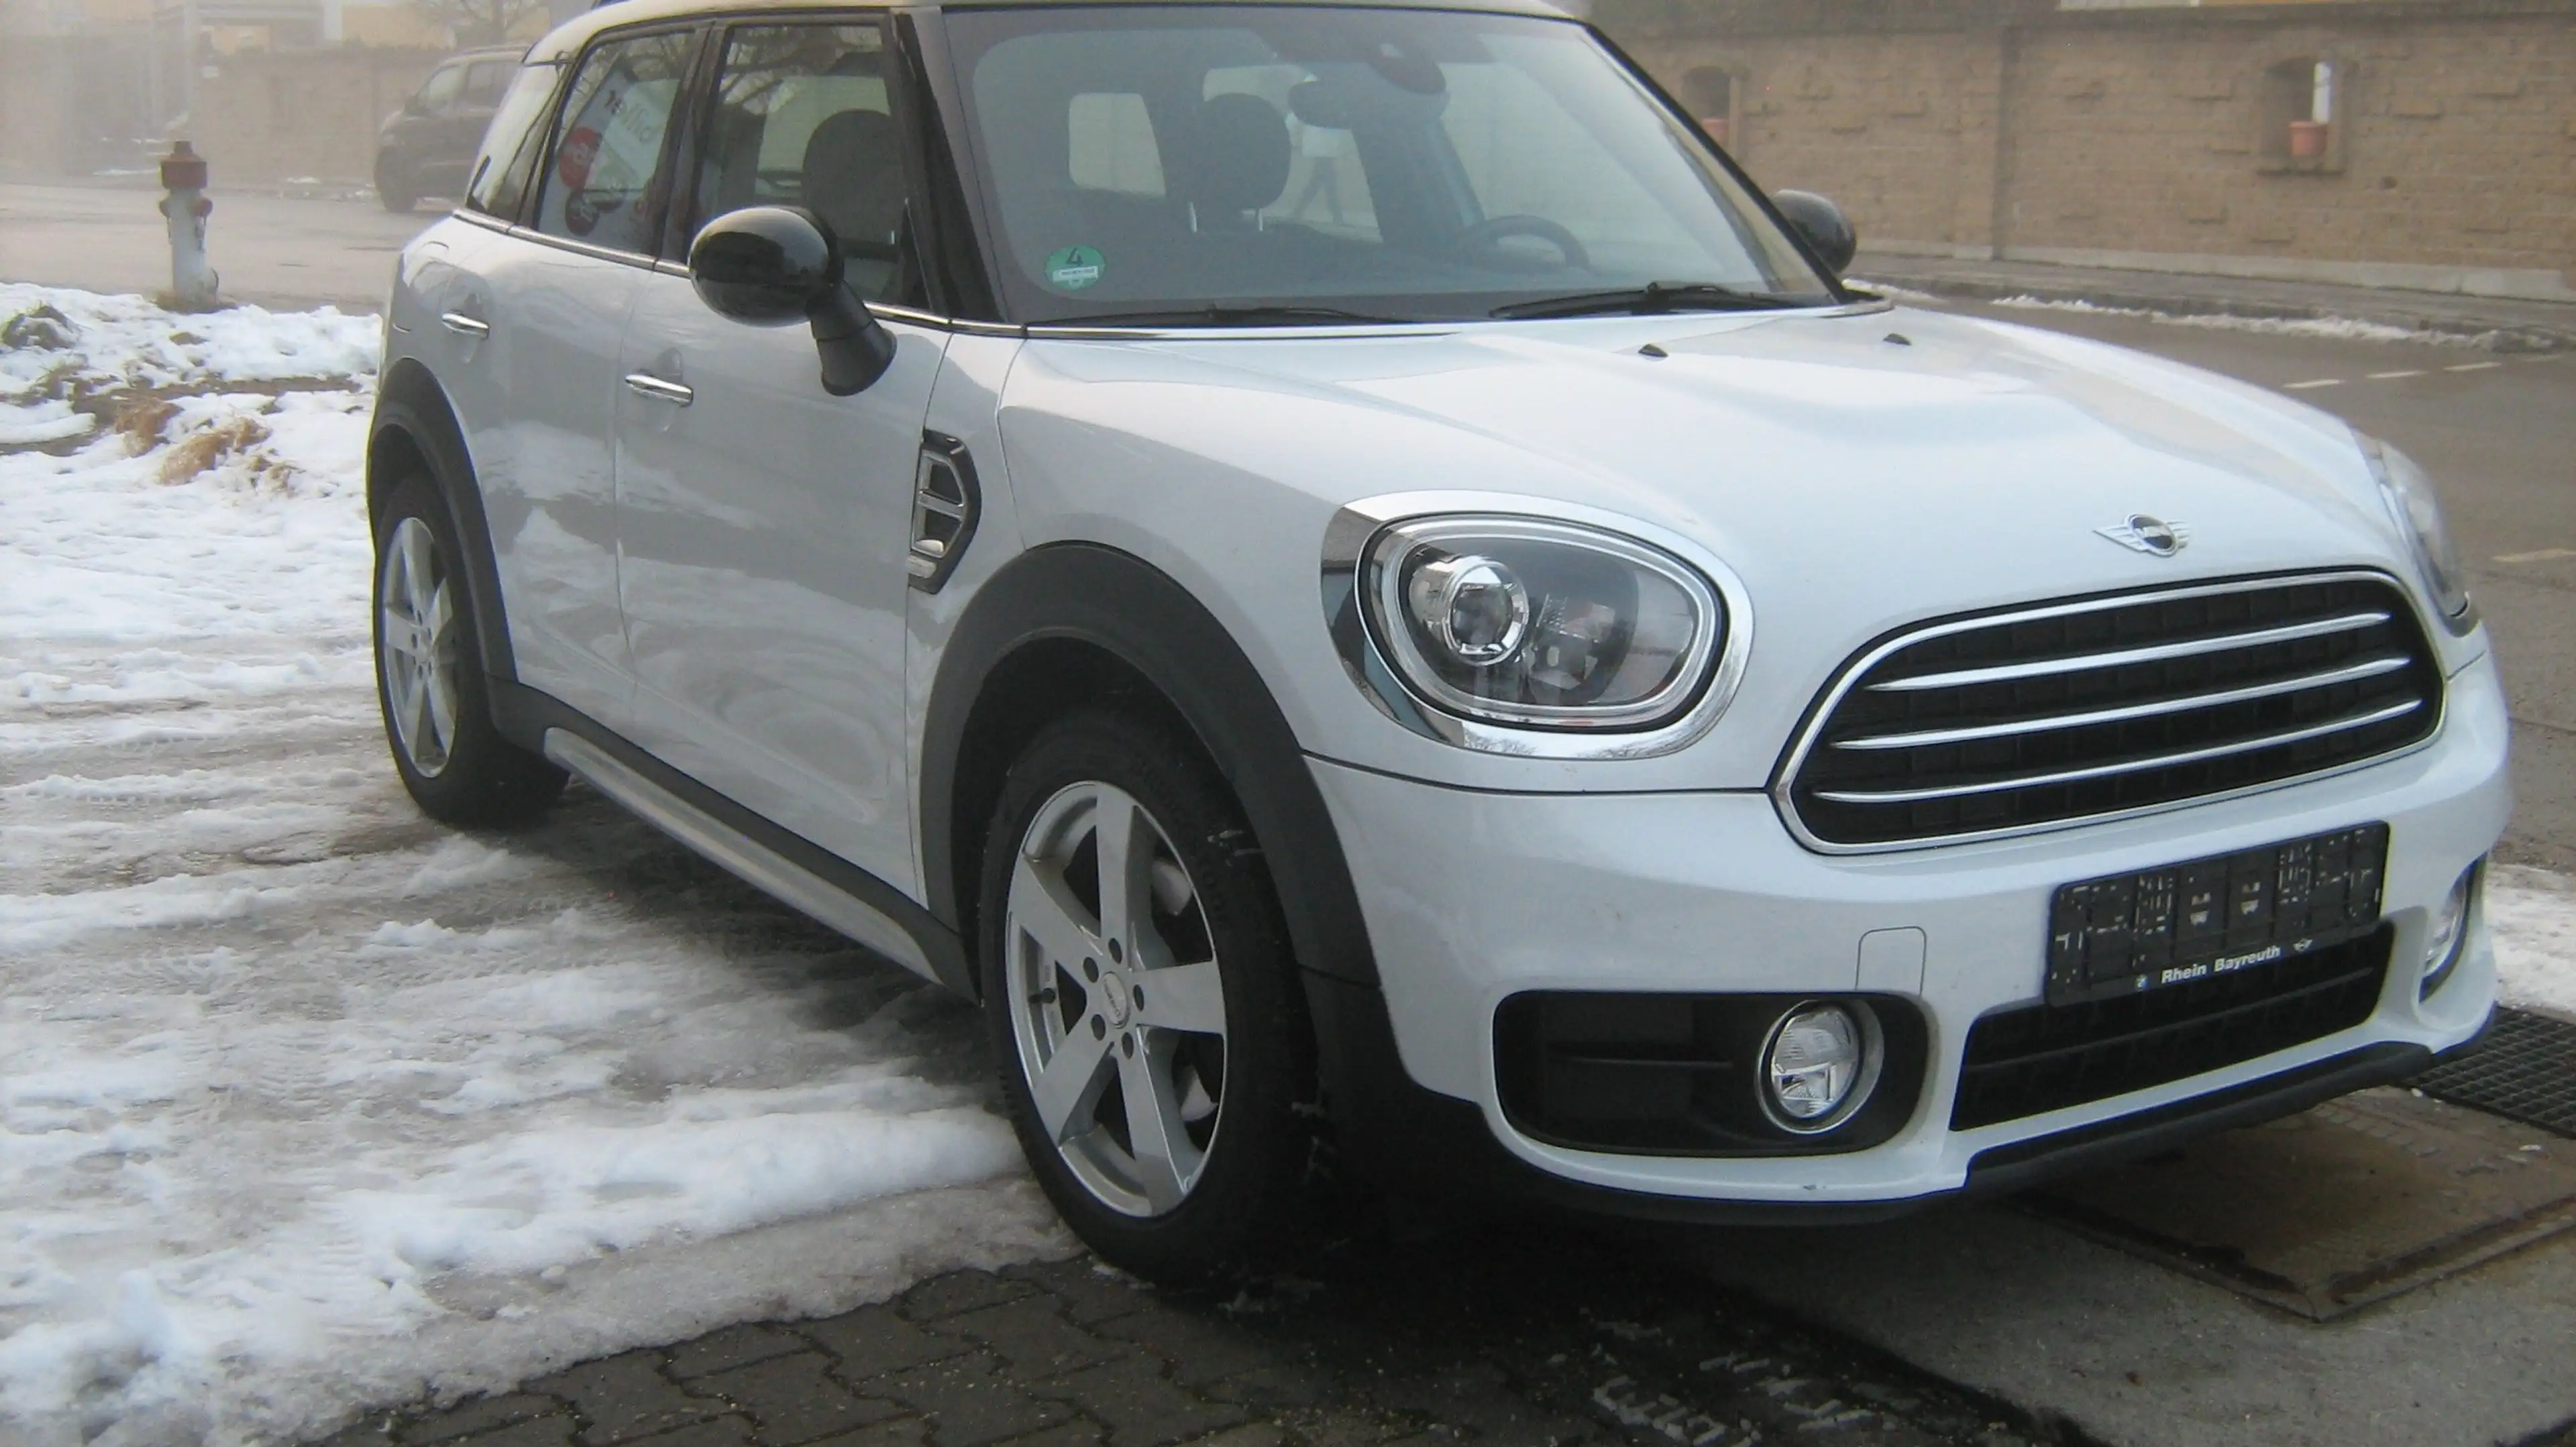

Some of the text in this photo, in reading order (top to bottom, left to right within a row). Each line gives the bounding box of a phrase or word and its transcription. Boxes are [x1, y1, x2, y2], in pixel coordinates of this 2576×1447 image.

[1065, 247, 1084, 266] 4
[2161, 945, 2281, 984] Rhein Bayreuth
